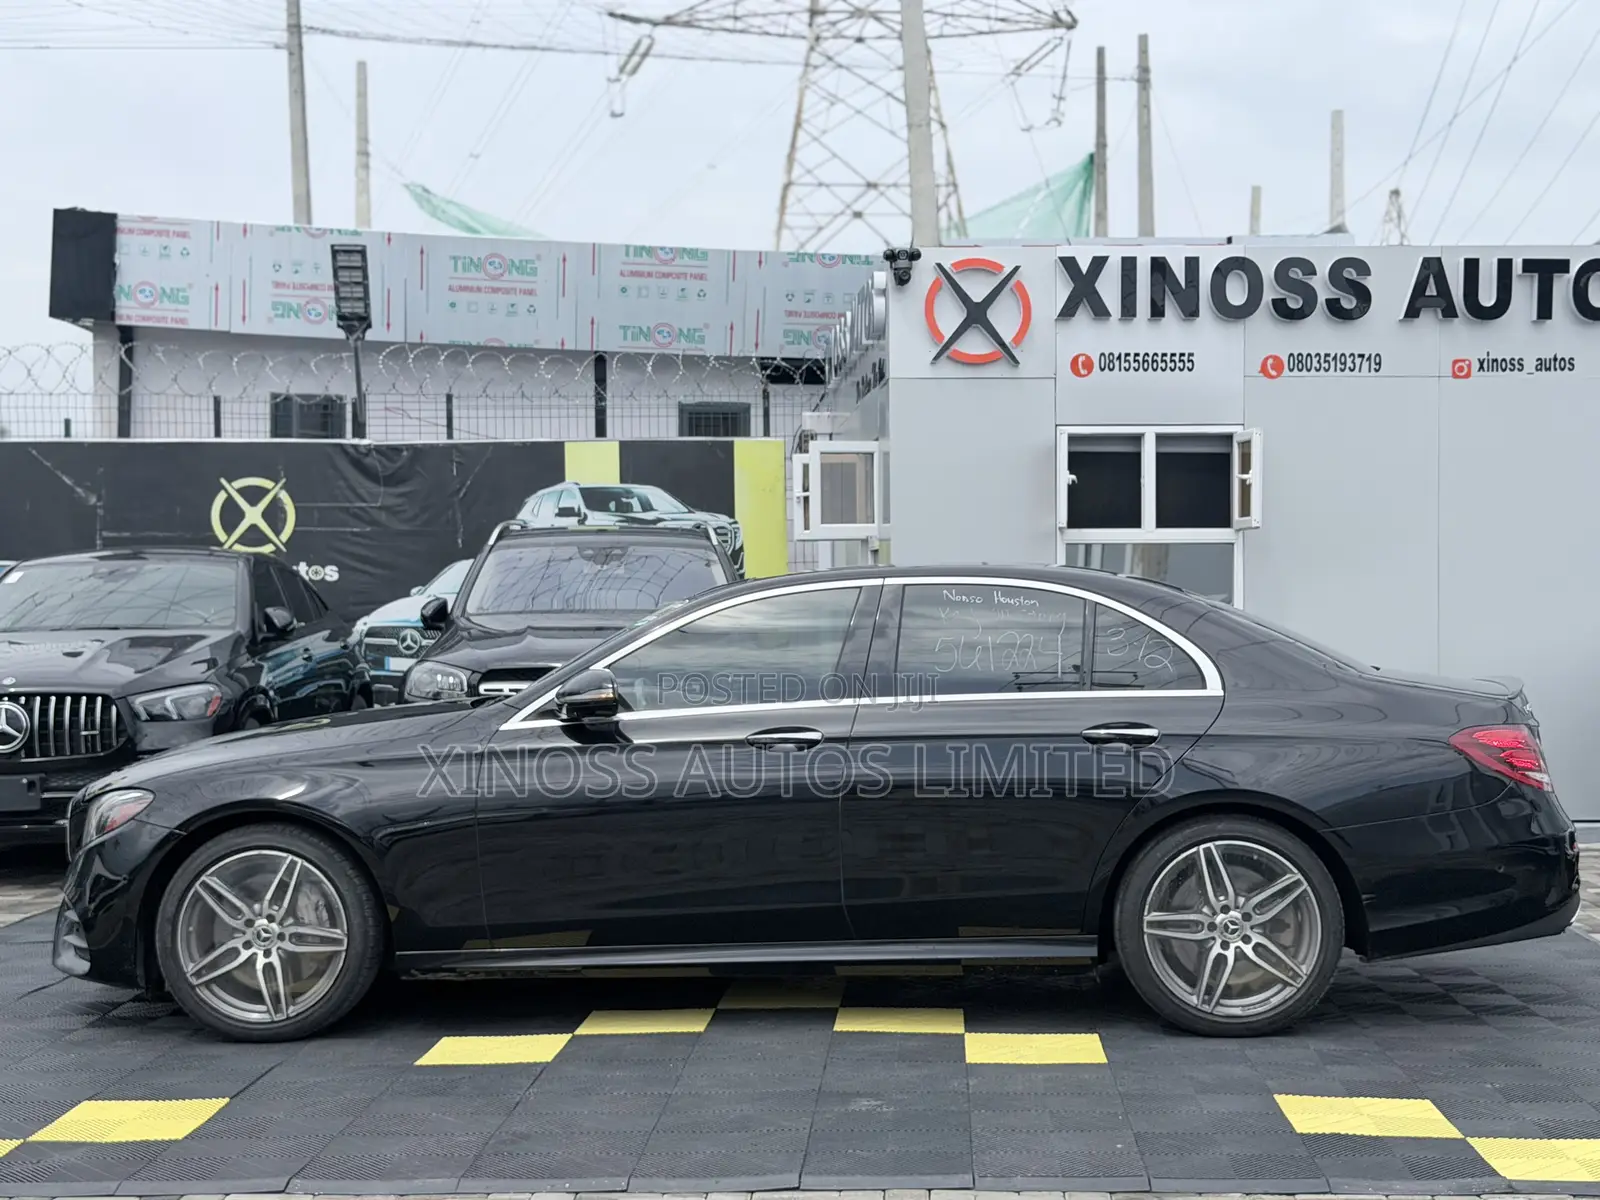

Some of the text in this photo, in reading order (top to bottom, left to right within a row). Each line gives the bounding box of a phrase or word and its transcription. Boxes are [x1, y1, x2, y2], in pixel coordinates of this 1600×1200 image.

[689, 272, 708, 281] PANEL
[1056, 255, 1372, 321] XINOSS
[1099, 352, 1195, 373] 08155665555
[1287, 352, 1382, 374] 08035193719
[1476, 351, 1576, 375] xinoss_autos
[291, 561, 340, 582] tos
